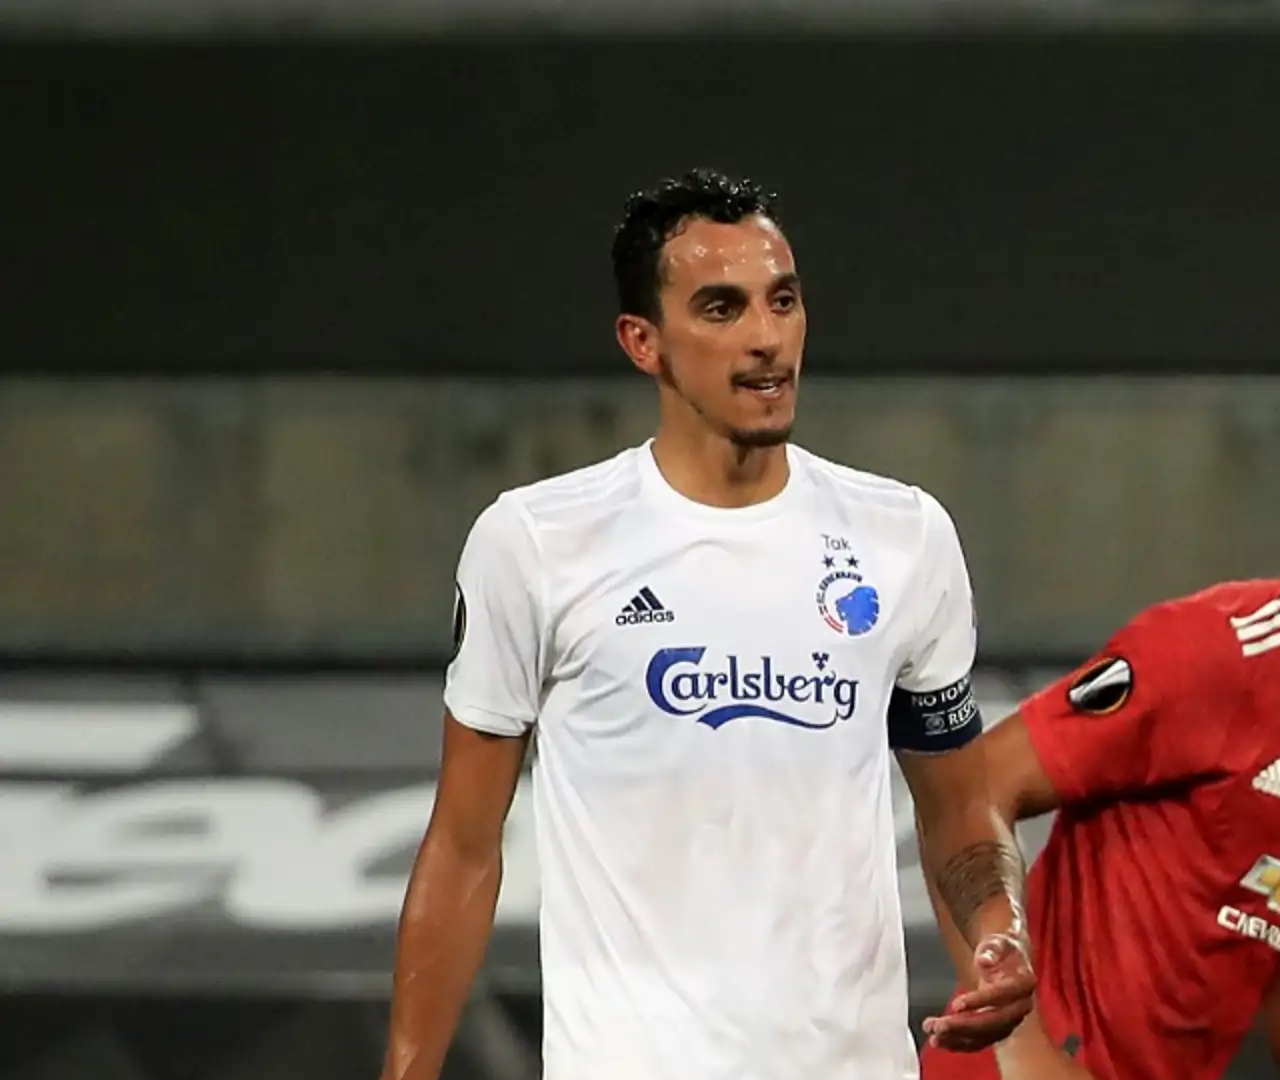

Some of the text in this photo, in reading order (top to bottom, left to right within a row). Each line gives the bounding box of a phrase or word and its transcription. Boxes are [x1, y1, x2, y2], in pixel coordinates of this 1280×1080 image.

[820, 533, 852, 551] Tak
[615, 608, 675, 626] adidas
[645, 645, 860, 731] Carlsberg
